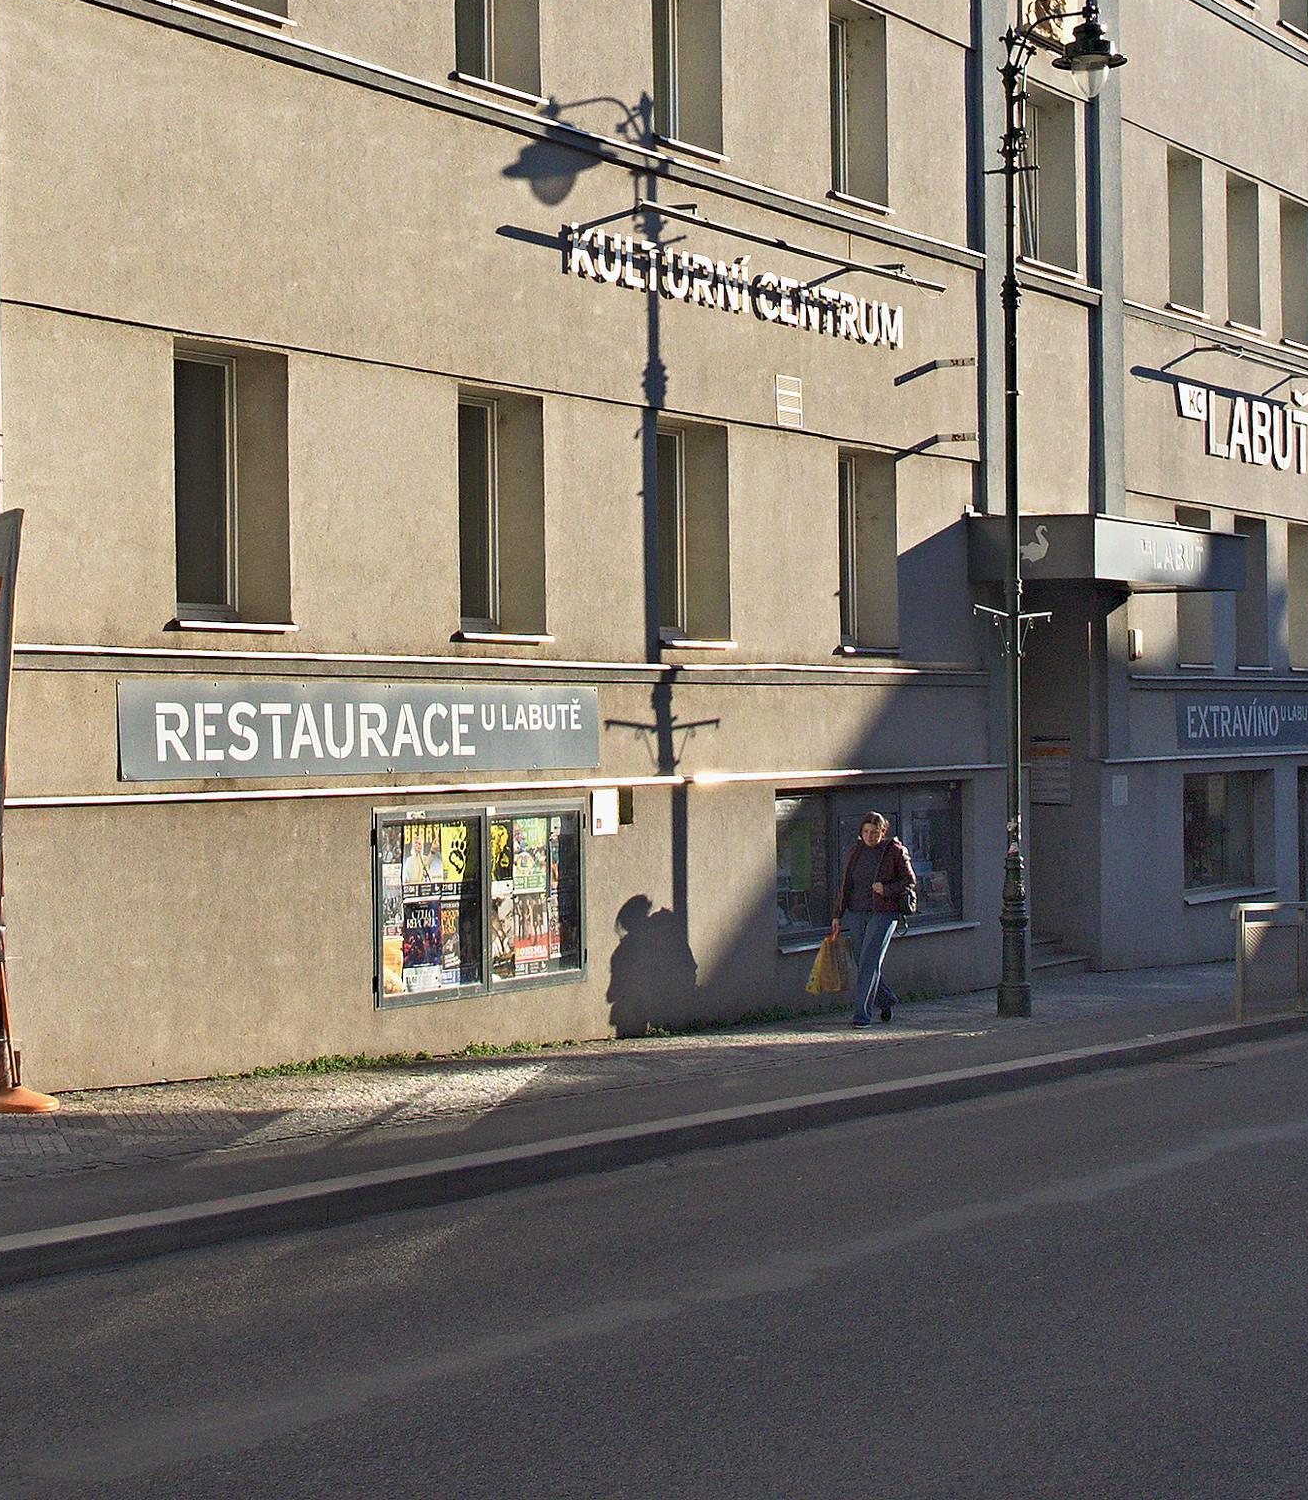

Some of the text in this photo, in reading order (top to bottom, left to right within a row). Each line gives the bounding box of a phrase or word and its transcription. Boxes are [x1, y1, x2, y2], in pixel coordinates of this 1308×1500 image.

[571, 222, 904, 349] KULTURNÍ CENTRUM
[155, 698, 582, 763] RESTAURACE U LABUTĚ
[1187, 698, 1280, 739] EXTRAVÍNO
[1280, 706, 1287, 721] U
